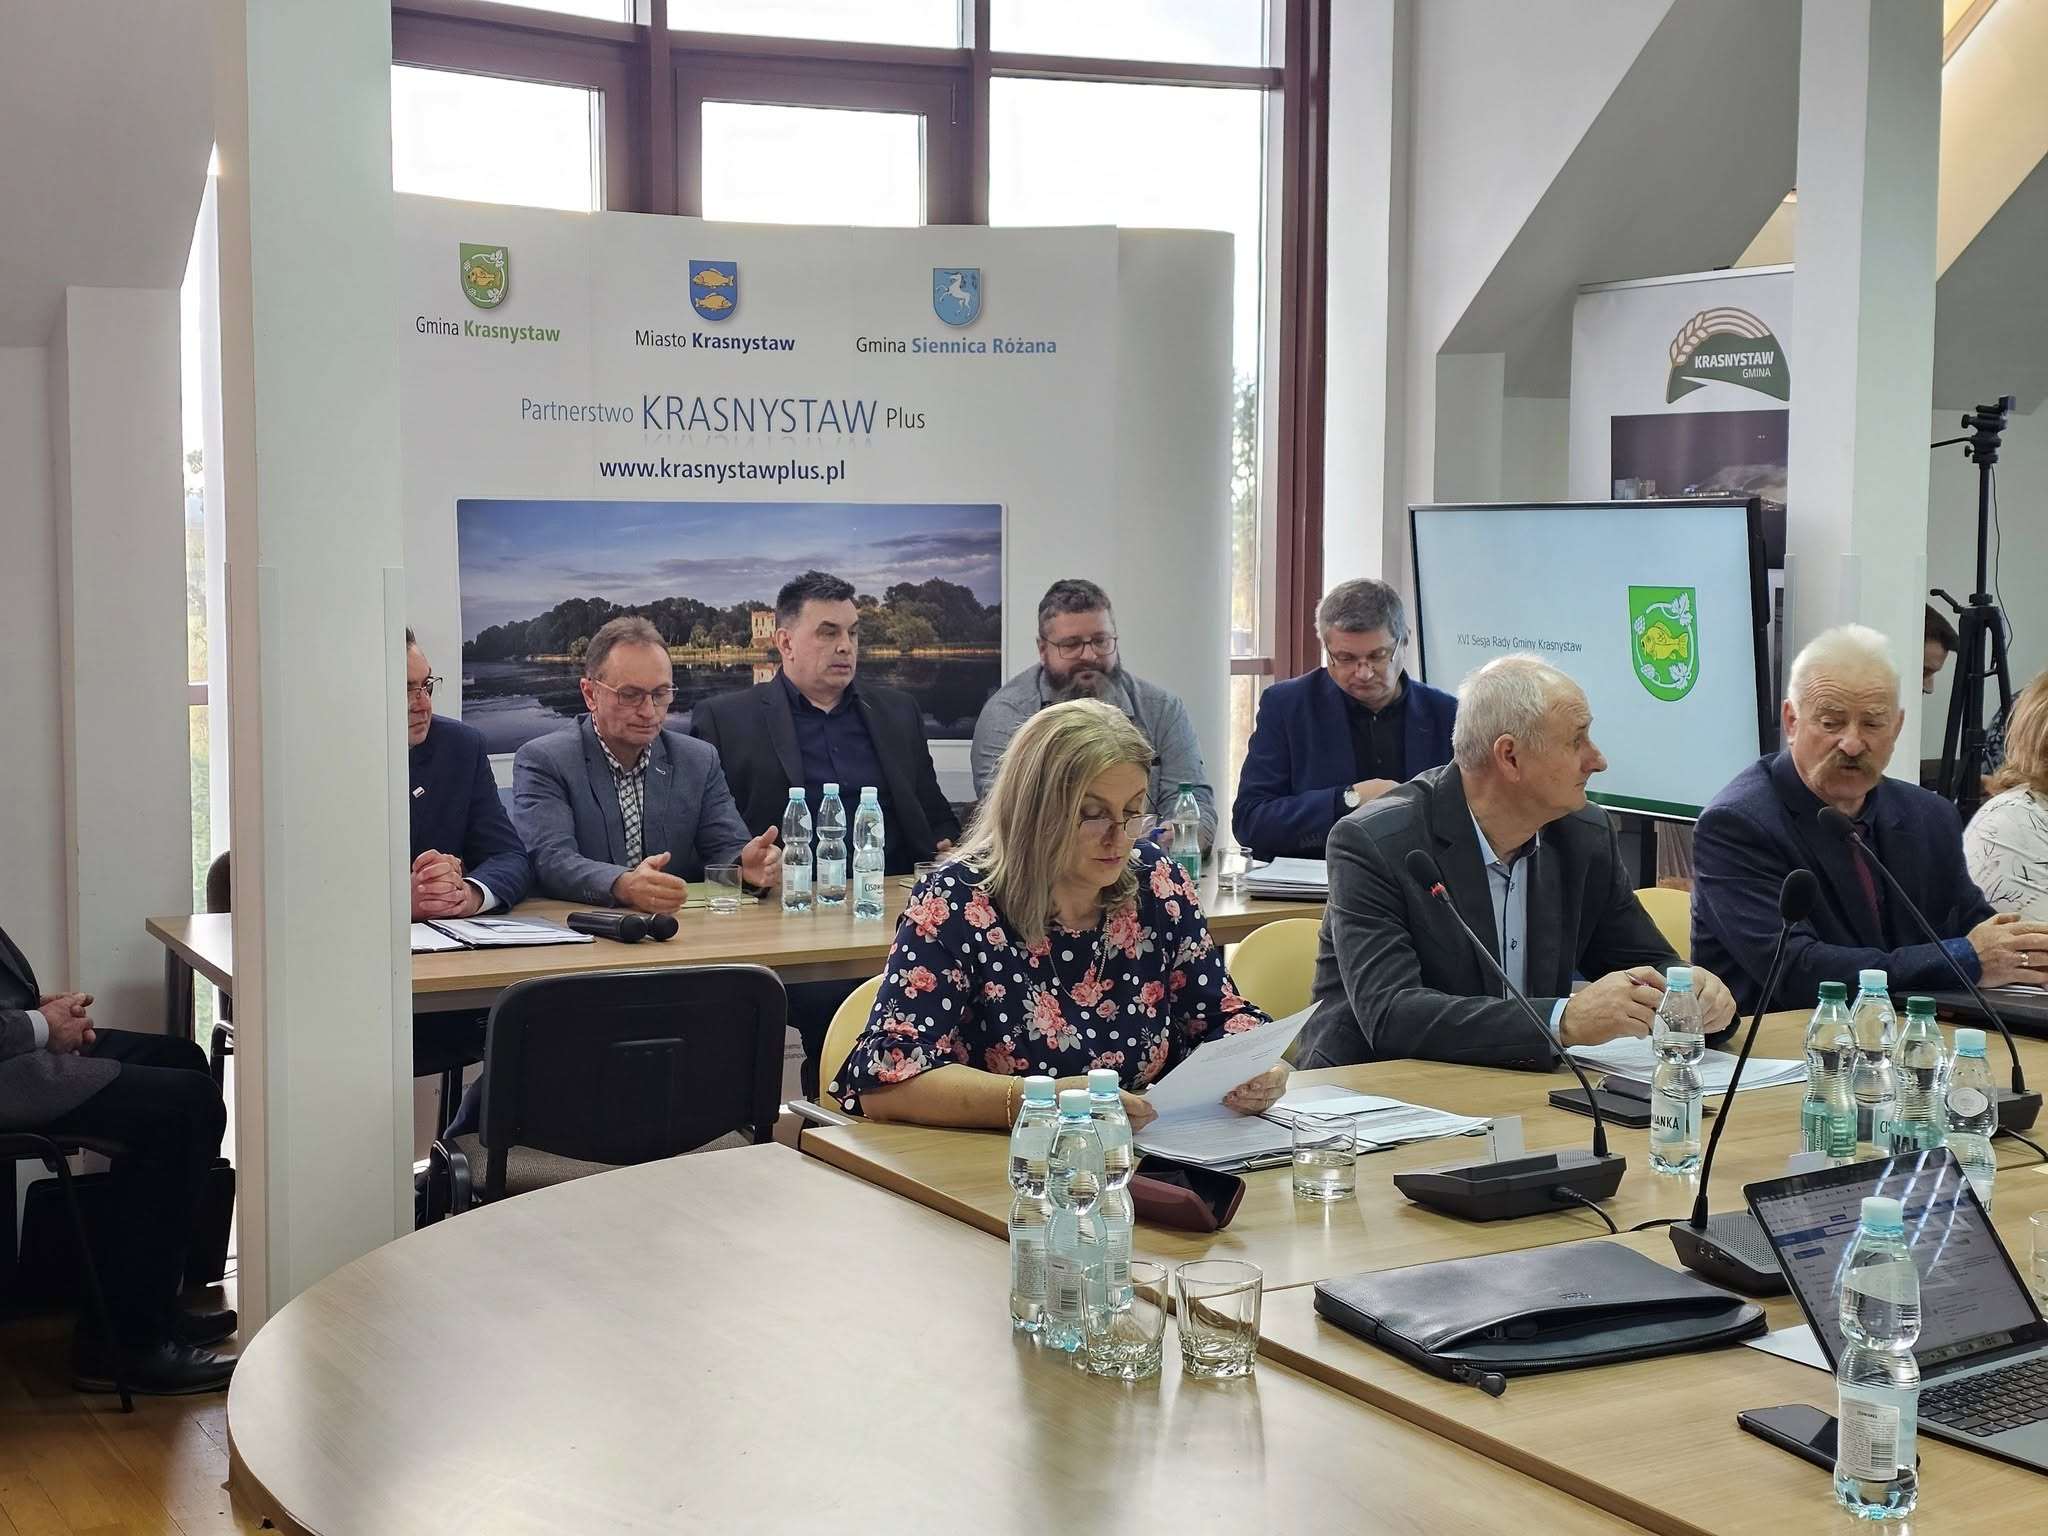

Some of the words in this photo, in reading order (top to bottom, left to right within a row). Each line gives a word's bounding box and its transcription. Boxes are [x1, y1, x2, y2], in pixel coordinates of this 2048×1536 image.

[415, 315, 459, 336] Gmina
[464, 319, 561, 344] Krasnystaw
[634, 329, 687, 348] Miasto
[692, 332, 796, 354] Krasnystaw
[855, 336, 906, 353] Gmina
[911, 337, 987, 354] Siennica
[992, 337, 1058, 354] Różana
[1694, 351, 1774, 368] KRASNYSTAW
[1742, 367, 1772, 378] GMINA
[521, 397, 635, 424] Partnerstwo
[642, 394, 878, 435] KRASNYSTAW
[886, 406, 926, 430] Plus
[599, 456, 847, 485] www.krasnystawplus.pl
[1456, 632, 1470, 645] XVI
[1471, 634, 1491, 648] Sesja
[1492, 635, 1511, 649] Rady
[1512, 637, 1536, 650] Gminy
[1538, 639, 1583, 653] Krasnystaw
